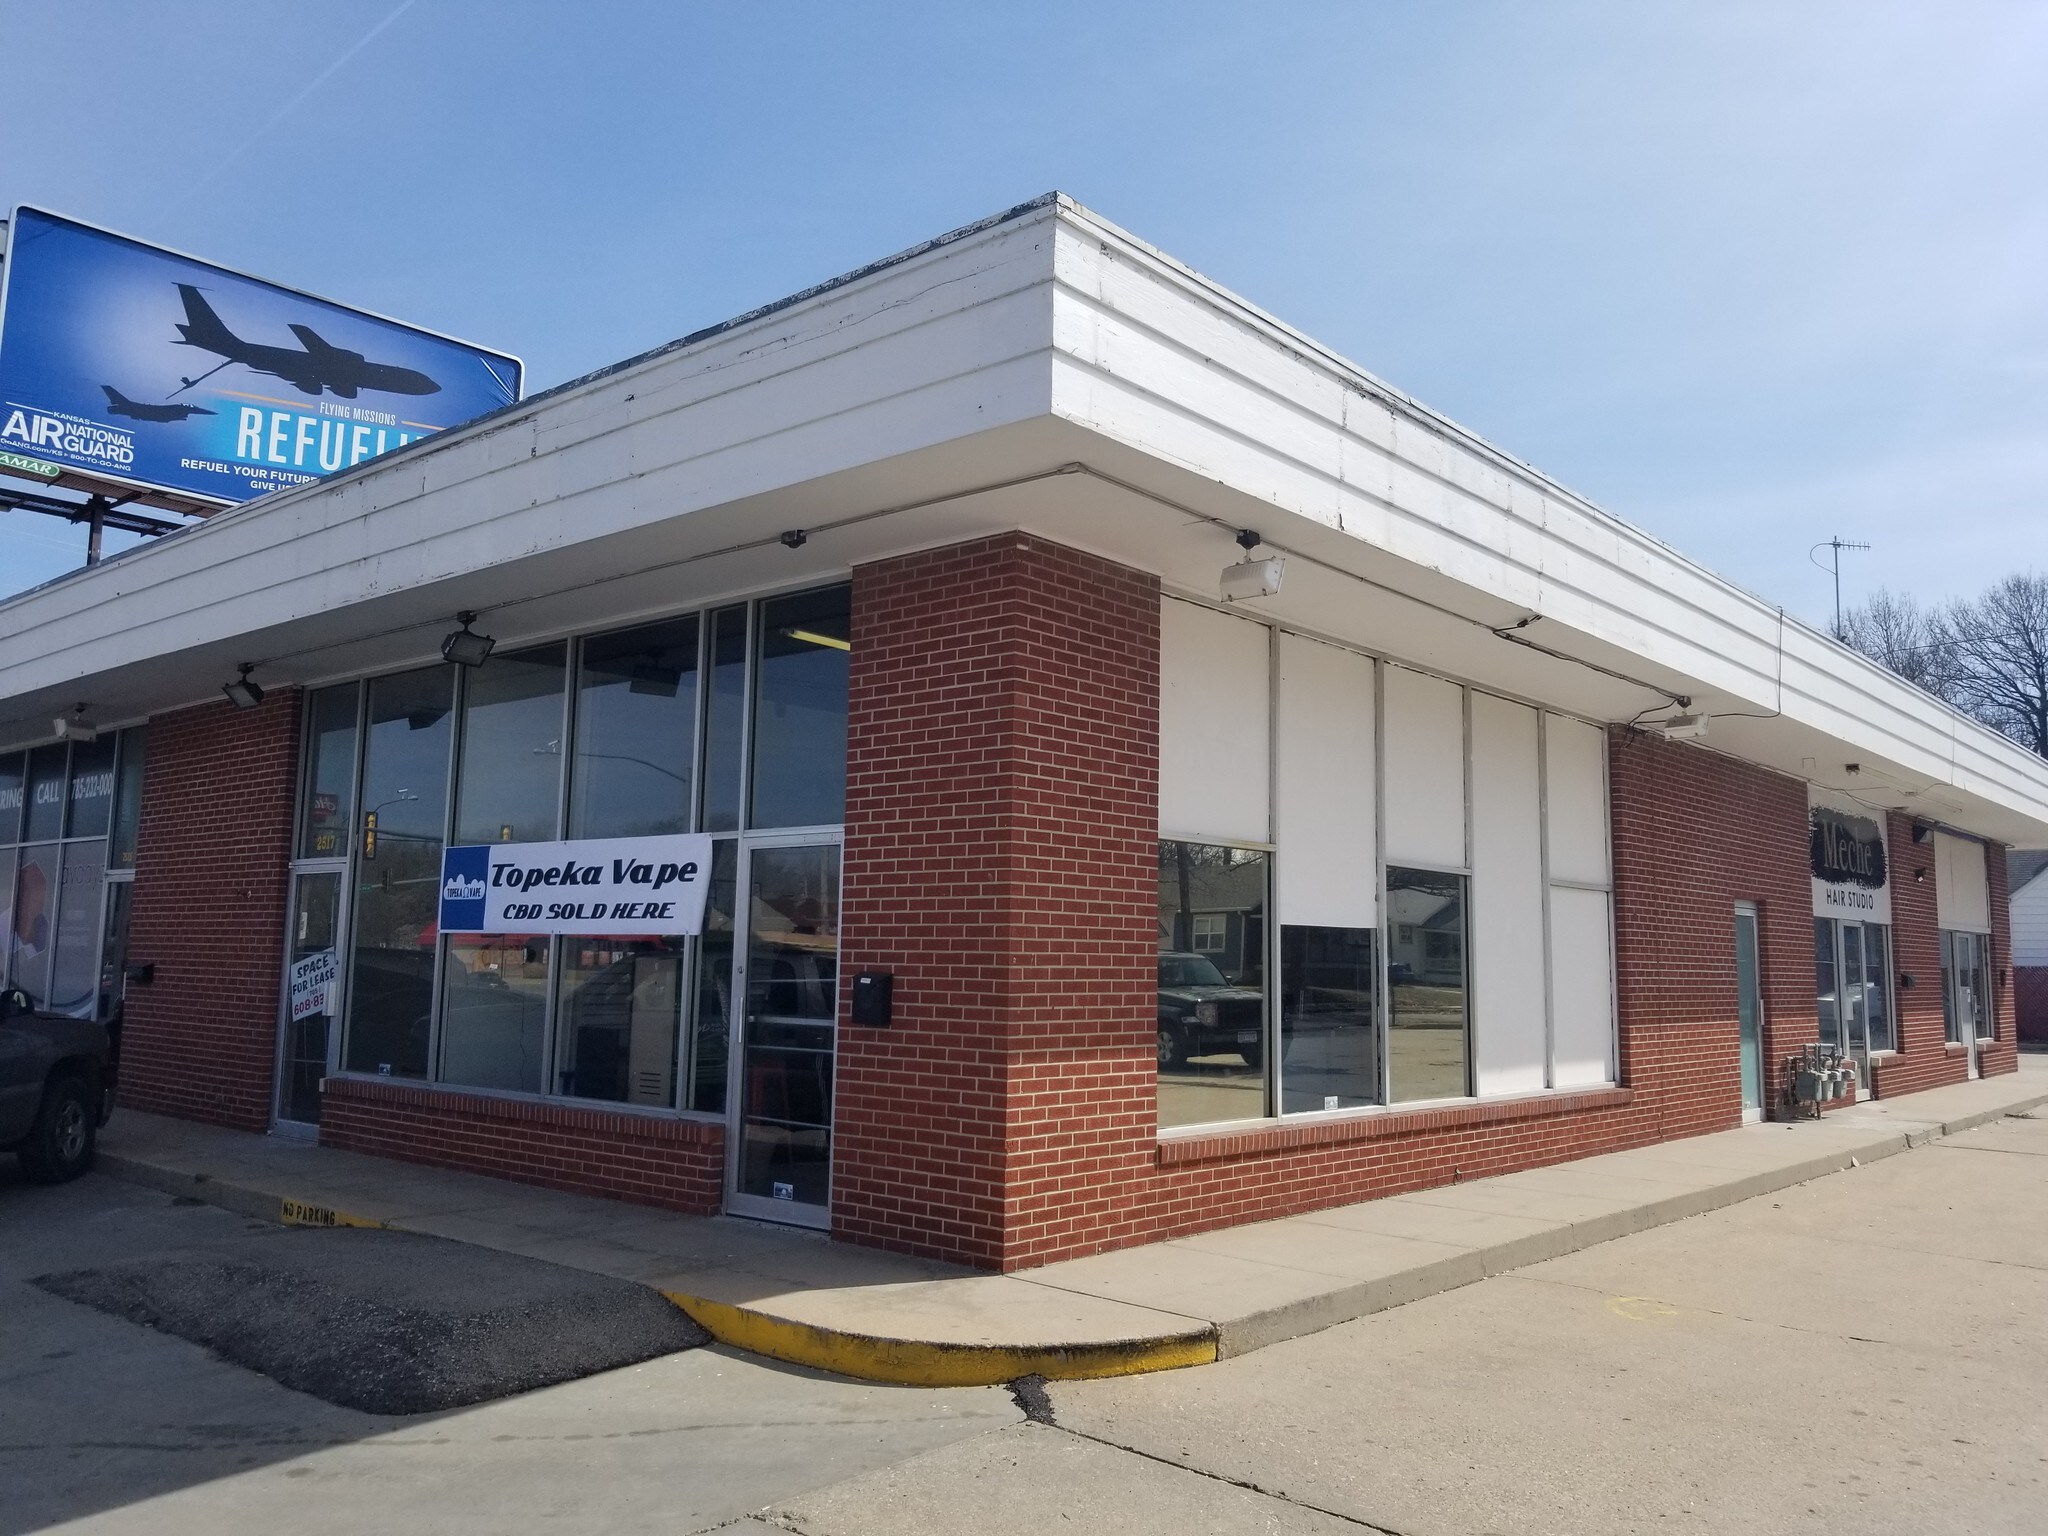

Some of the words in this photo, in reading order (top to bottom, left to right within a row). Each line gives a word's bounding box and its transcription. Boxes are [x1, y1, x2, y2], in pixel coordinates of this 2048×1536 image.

[53, 411, 91, 425] KANSAS
[319, 401, 350, 419] FLYING
[352, 404, 396, 426] MISSIONS
[1, 410, 64, 449] AIR
[65, 422, 135, 449] NATIONAL
[64, 435, 134, 464] GUARD
[0, 455, 52, 474] AMAR
[70, 453, 132, 472] 800-TO-GO-ANG
[180, 458, 231, 474] REFUEL
[233, 465, 267, 480] YOUR
[249, 480, 276, 491] GIVE
[0, 787, 23, 810] RING
[37, 781, 60, 804] CALL
[491, 861, 602, 893] Topeka
[612, 858, 698, 890] Vape
[447, 887, 463, 898] TOPEKA
[469, 887, 482, 898] VAPE
[1826, 888, 1846, 907] HAIR
[1848, 891, 1874, 910] STUDIO
[503, 903, 543, 920] CBD
[546, 903, 608, 920] SOLD
[610, 902, 676, 919] HERE
[297, 954, 330, 979] SPACE
[292, 979, 308, 996] FOR
[309, 967, 335, 988] LEASE
[282, 1201, 294, 1217] NO
[296, 1205, 336, 1226] PARKING
